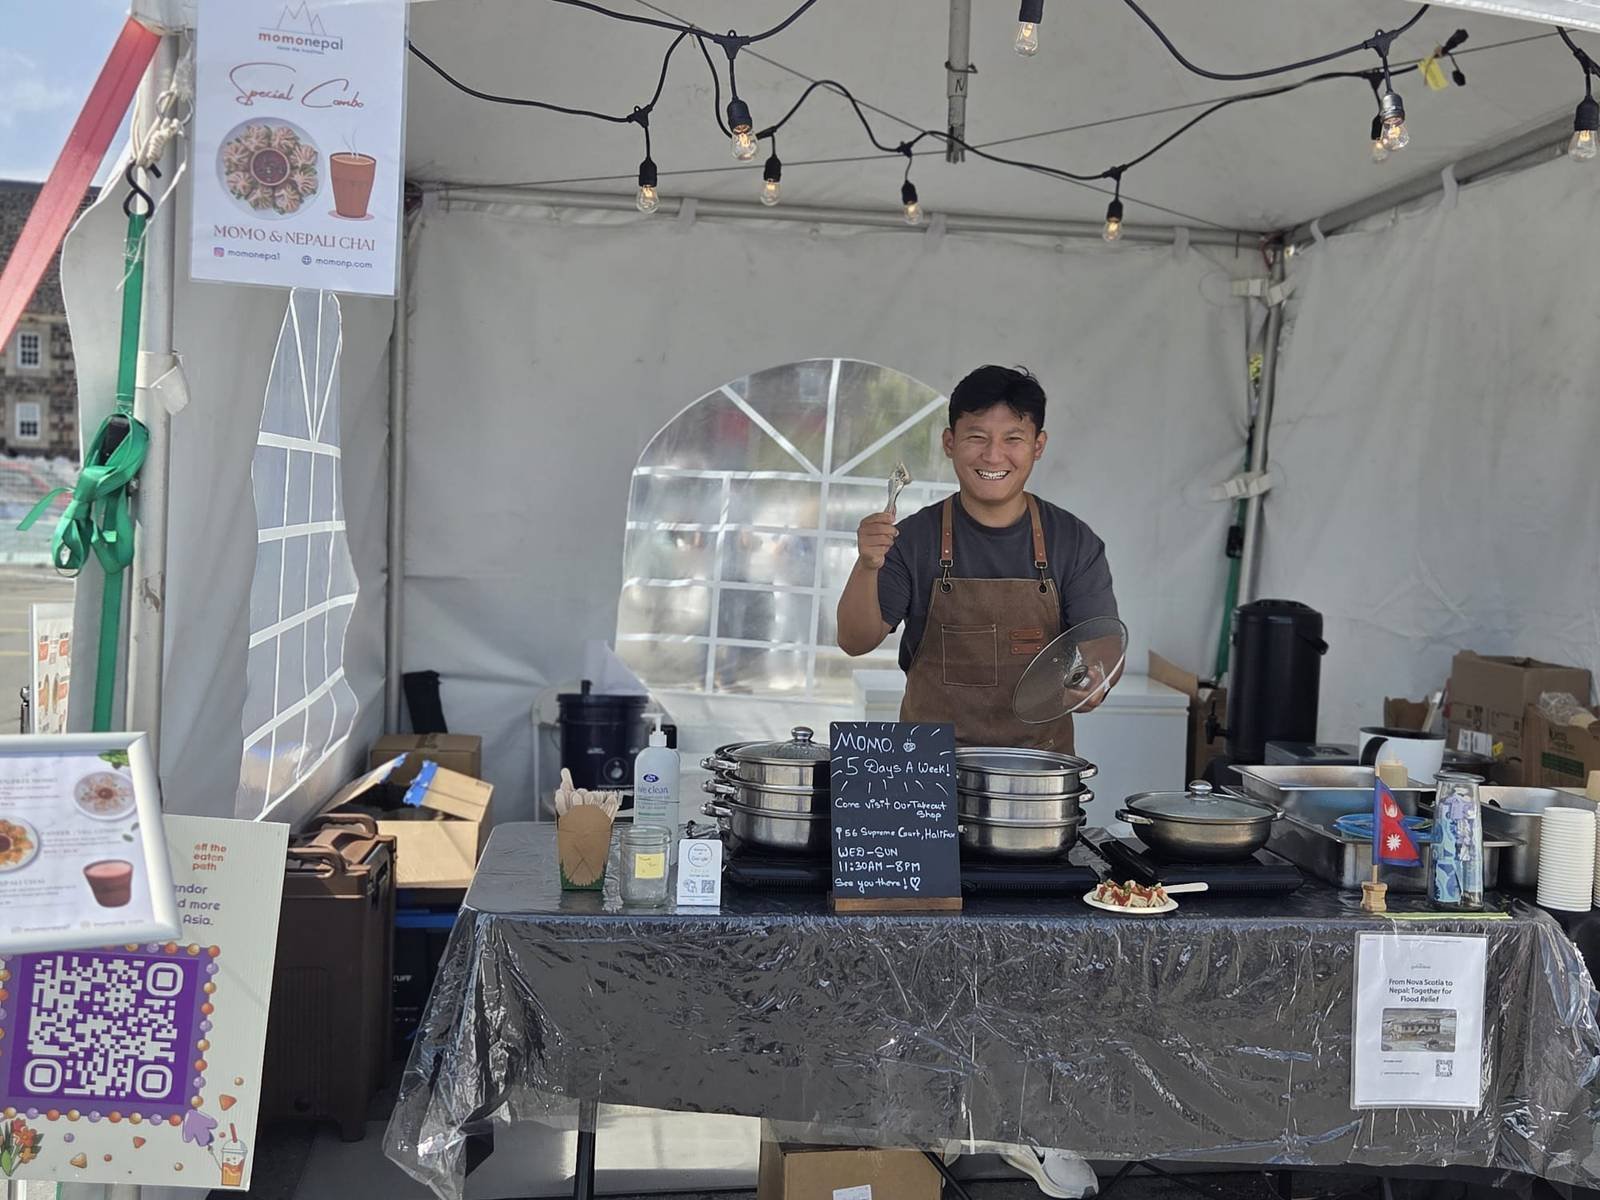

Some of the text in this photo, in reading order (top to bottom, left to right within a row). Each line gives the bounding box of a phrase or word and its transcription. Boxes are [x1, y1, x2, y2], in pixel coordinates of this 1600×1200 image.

[258, 32, 344, 51] momonepal
[229, 62, 364, 108] Special Combo
[213, 224, 376, 251] MOMO & NEPALI CHAI
[227, 248, 373, 269] momonepal momonp.com
[845, 756, 951, 779] 5 Days A Week!
[835, 797, 860, 809] Come
[865, 797, 891, 810] visit
[916, 809, 942, 822] Shop
[844, 829, 858, 838] 56
[860, 826, 895, 838] Supreme
[210, 843, 228, 853] the
[191, 862, 217, 871] path
[834, 877, 854, 887] See
[857, 879, 874, 894] you
[189, 900, 221, 911] more
[183, 913, 214, 926] Asia.
[1388, 978, 1406, 986] From
[1406, 978, 1423, 986] Nova
[1424, 978, 1444, 986] Scotia
[1411, 987, 1441, 995] Together
[1442, 987, 1452, 995] for
